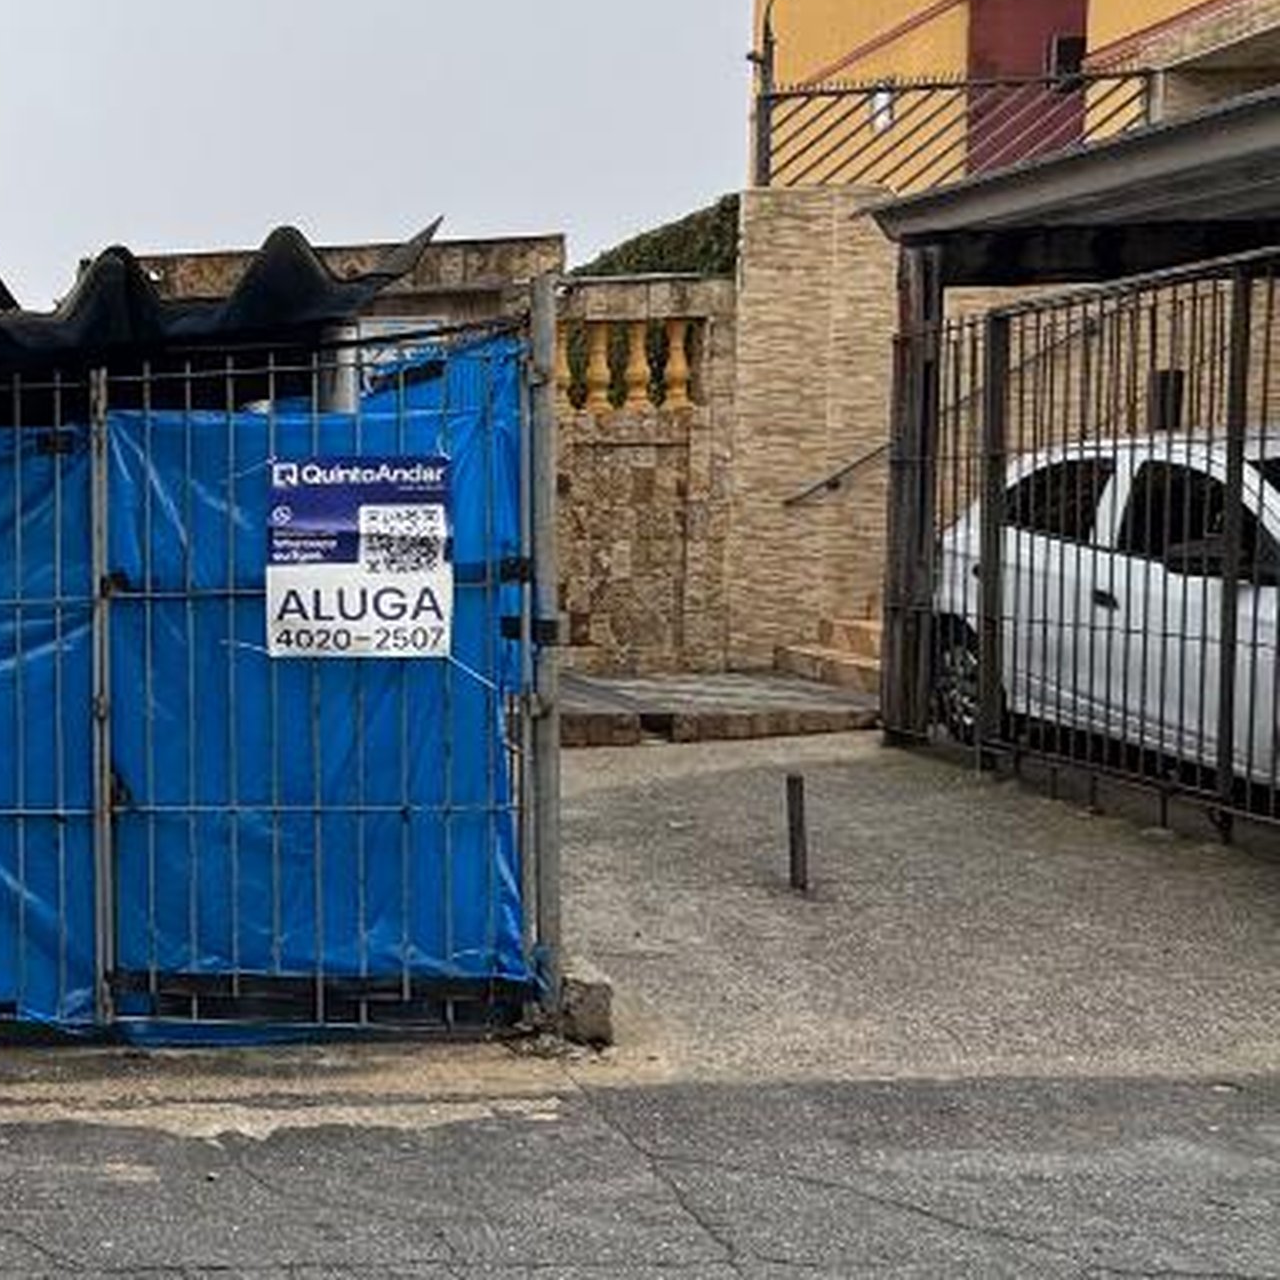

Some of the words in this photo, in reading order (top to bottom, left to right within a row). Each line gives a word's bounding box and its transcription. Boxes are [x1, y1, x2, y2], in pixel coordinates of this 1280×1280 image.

[301, 463, 444, 484] QuintoAndar
[277, 587, 444, 622] ALUGA
[276, 626, 444, 651] 4020-2507
